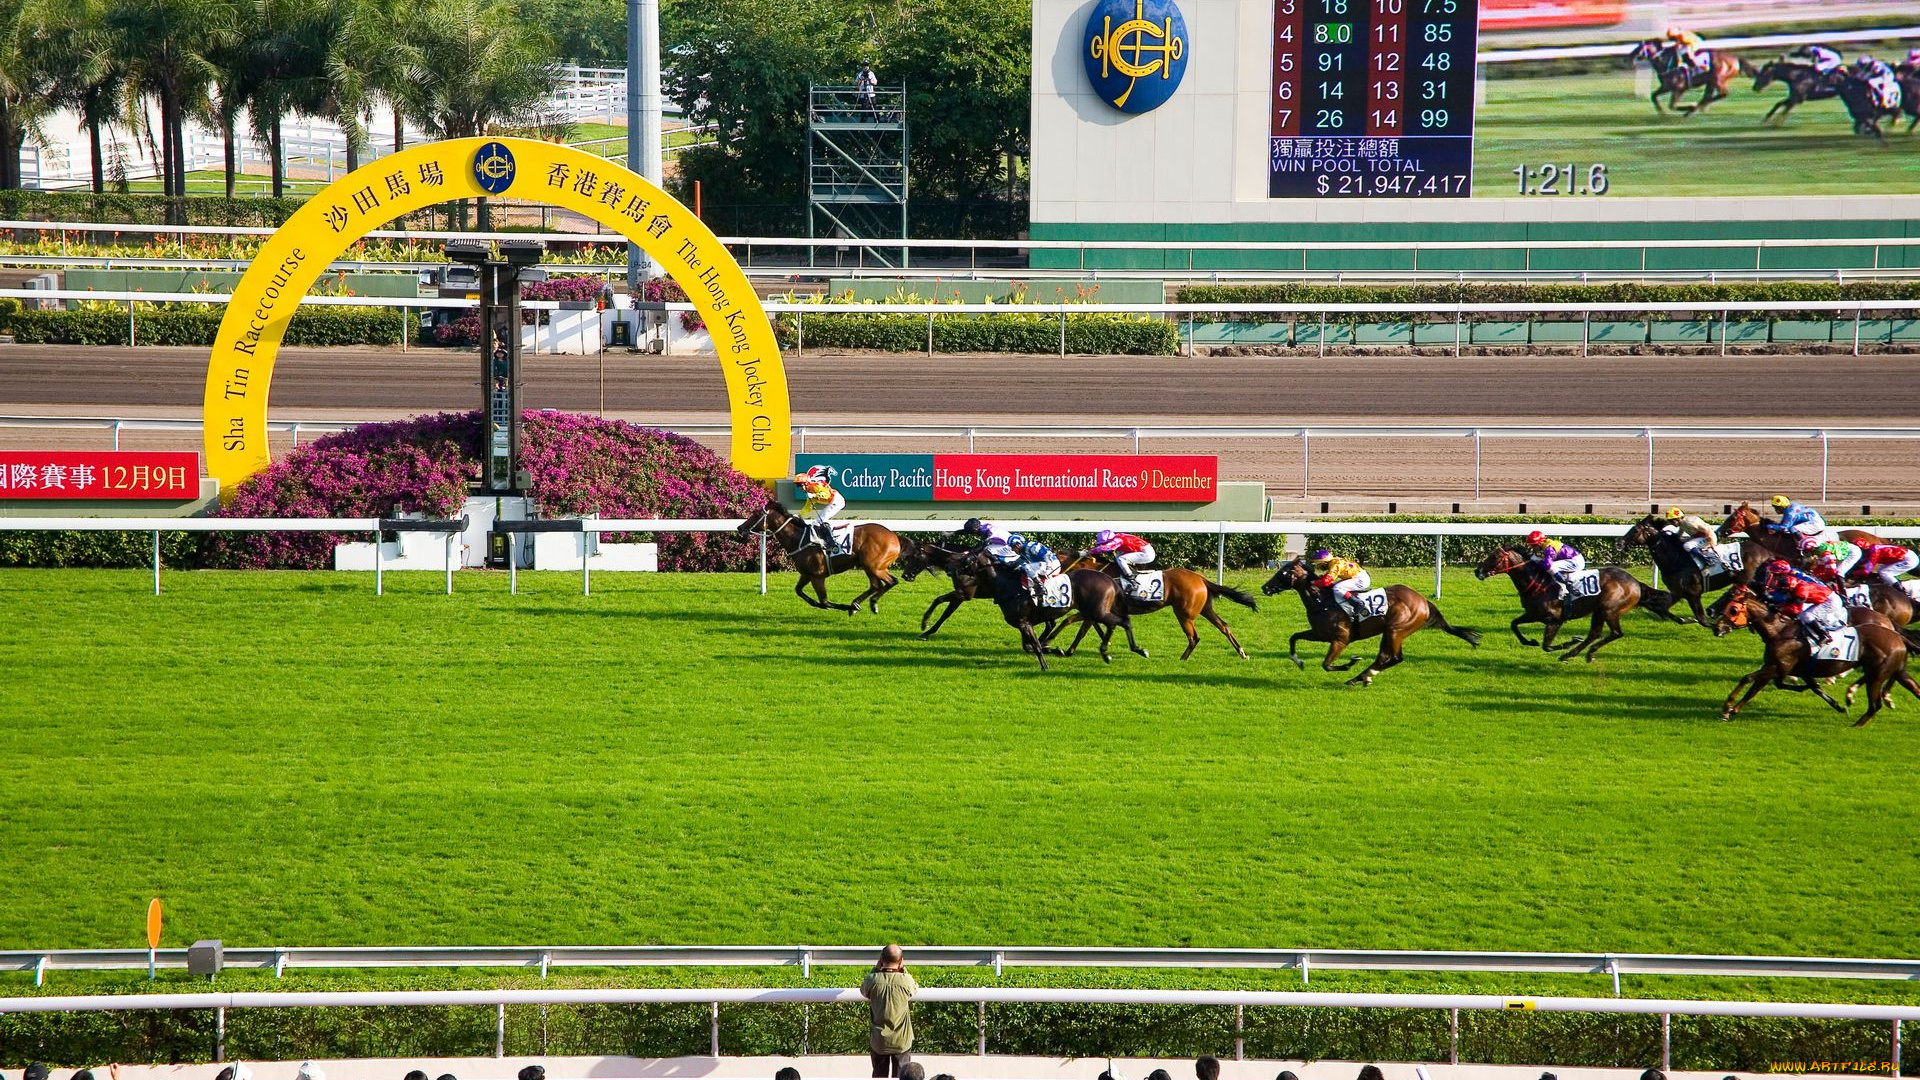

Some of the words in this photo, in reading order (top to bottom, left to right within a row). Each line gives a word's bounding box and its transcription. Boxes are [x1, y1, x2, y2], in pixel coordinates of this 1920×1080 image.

[1282, 0, 1295, 14] 3
[1321, 0, 1348, 14] 18
[1376, 0, 1401, 14] 10
[1422, 0, 1457, 14] 7.5
[1280, 24, 1294, 43] 4
[1315, 24, 1351, 43] 8.0
[1375, 24, 1399, 43] 11
[1424, 24, 1452, 43] 85
[1280, 53, 1294, 71] 5
[1318, 53, 1343, 71] 91
[1374, 53, 1400, 71] 12
[1422, 53, 1451, 71] 48
[1279, 81, 1292, 100] 6
[1319, 81, 1344, 100] 14
[1373, 81, 1399, 100] 13
[1422, 81, 1448, 100] 31
[1278, 110, 1293, 128] 7
[1316, 110, 1344, 128] 26
[1371, 110, 1398, 128] 14
[1421, 110, 1449, 128] 99
[1273, 139, 1399, 158] 獨贏投注總額
[1272, 159, 1306, 172] WIN
[1312, 159, 1361, 172] POOL
[1368, 159, 1425, 172] TOTAL
[1317, 175, 1330, 195] $
[1338, 175, 1467, 196] 21,947,417
[1513, 163, 1608, 195] 1:21.6
[323, 160, 445, 233] 沙田馬場
[547, 162, 674, 240] 香港賽馬會
[676, 238, 701, 269] The
[698, 265, 731, 312] Hong
[233, 247, 306, 356] Racecourse
[725, 309, 750, 354] Kong
[224, 368, 250, 400] Tin
[736, 357, 767, 408] Jockey
[224, 417, 245, 451] Sha
[752, 415, 772, 452] Club
[0, 463, 96, 490] 際賽事
[102, 465, 186, 490] 12月9日
[841, 467, 887, 493] Cathay
[890, 467, 932, 488] Pacific
[936, 468, 972, 494] Hong
[976, 468, 1011, 494] Kong
[1014, 468, 1098, 488] International
[1102, 468, 1138, 489] Races
[1141, 470, 1148, 489] 9
[1152, 469, 1212, 489] December
[841, 533, 851, 553] 4
[1059, 583, 1070, 606] 3
[1150, 578, 1162, 600] 2
[1580, 574, 1599, 596] 10
[1365, 594, 1385, 615] 12
[1843, 634, 1856, 659] 7
